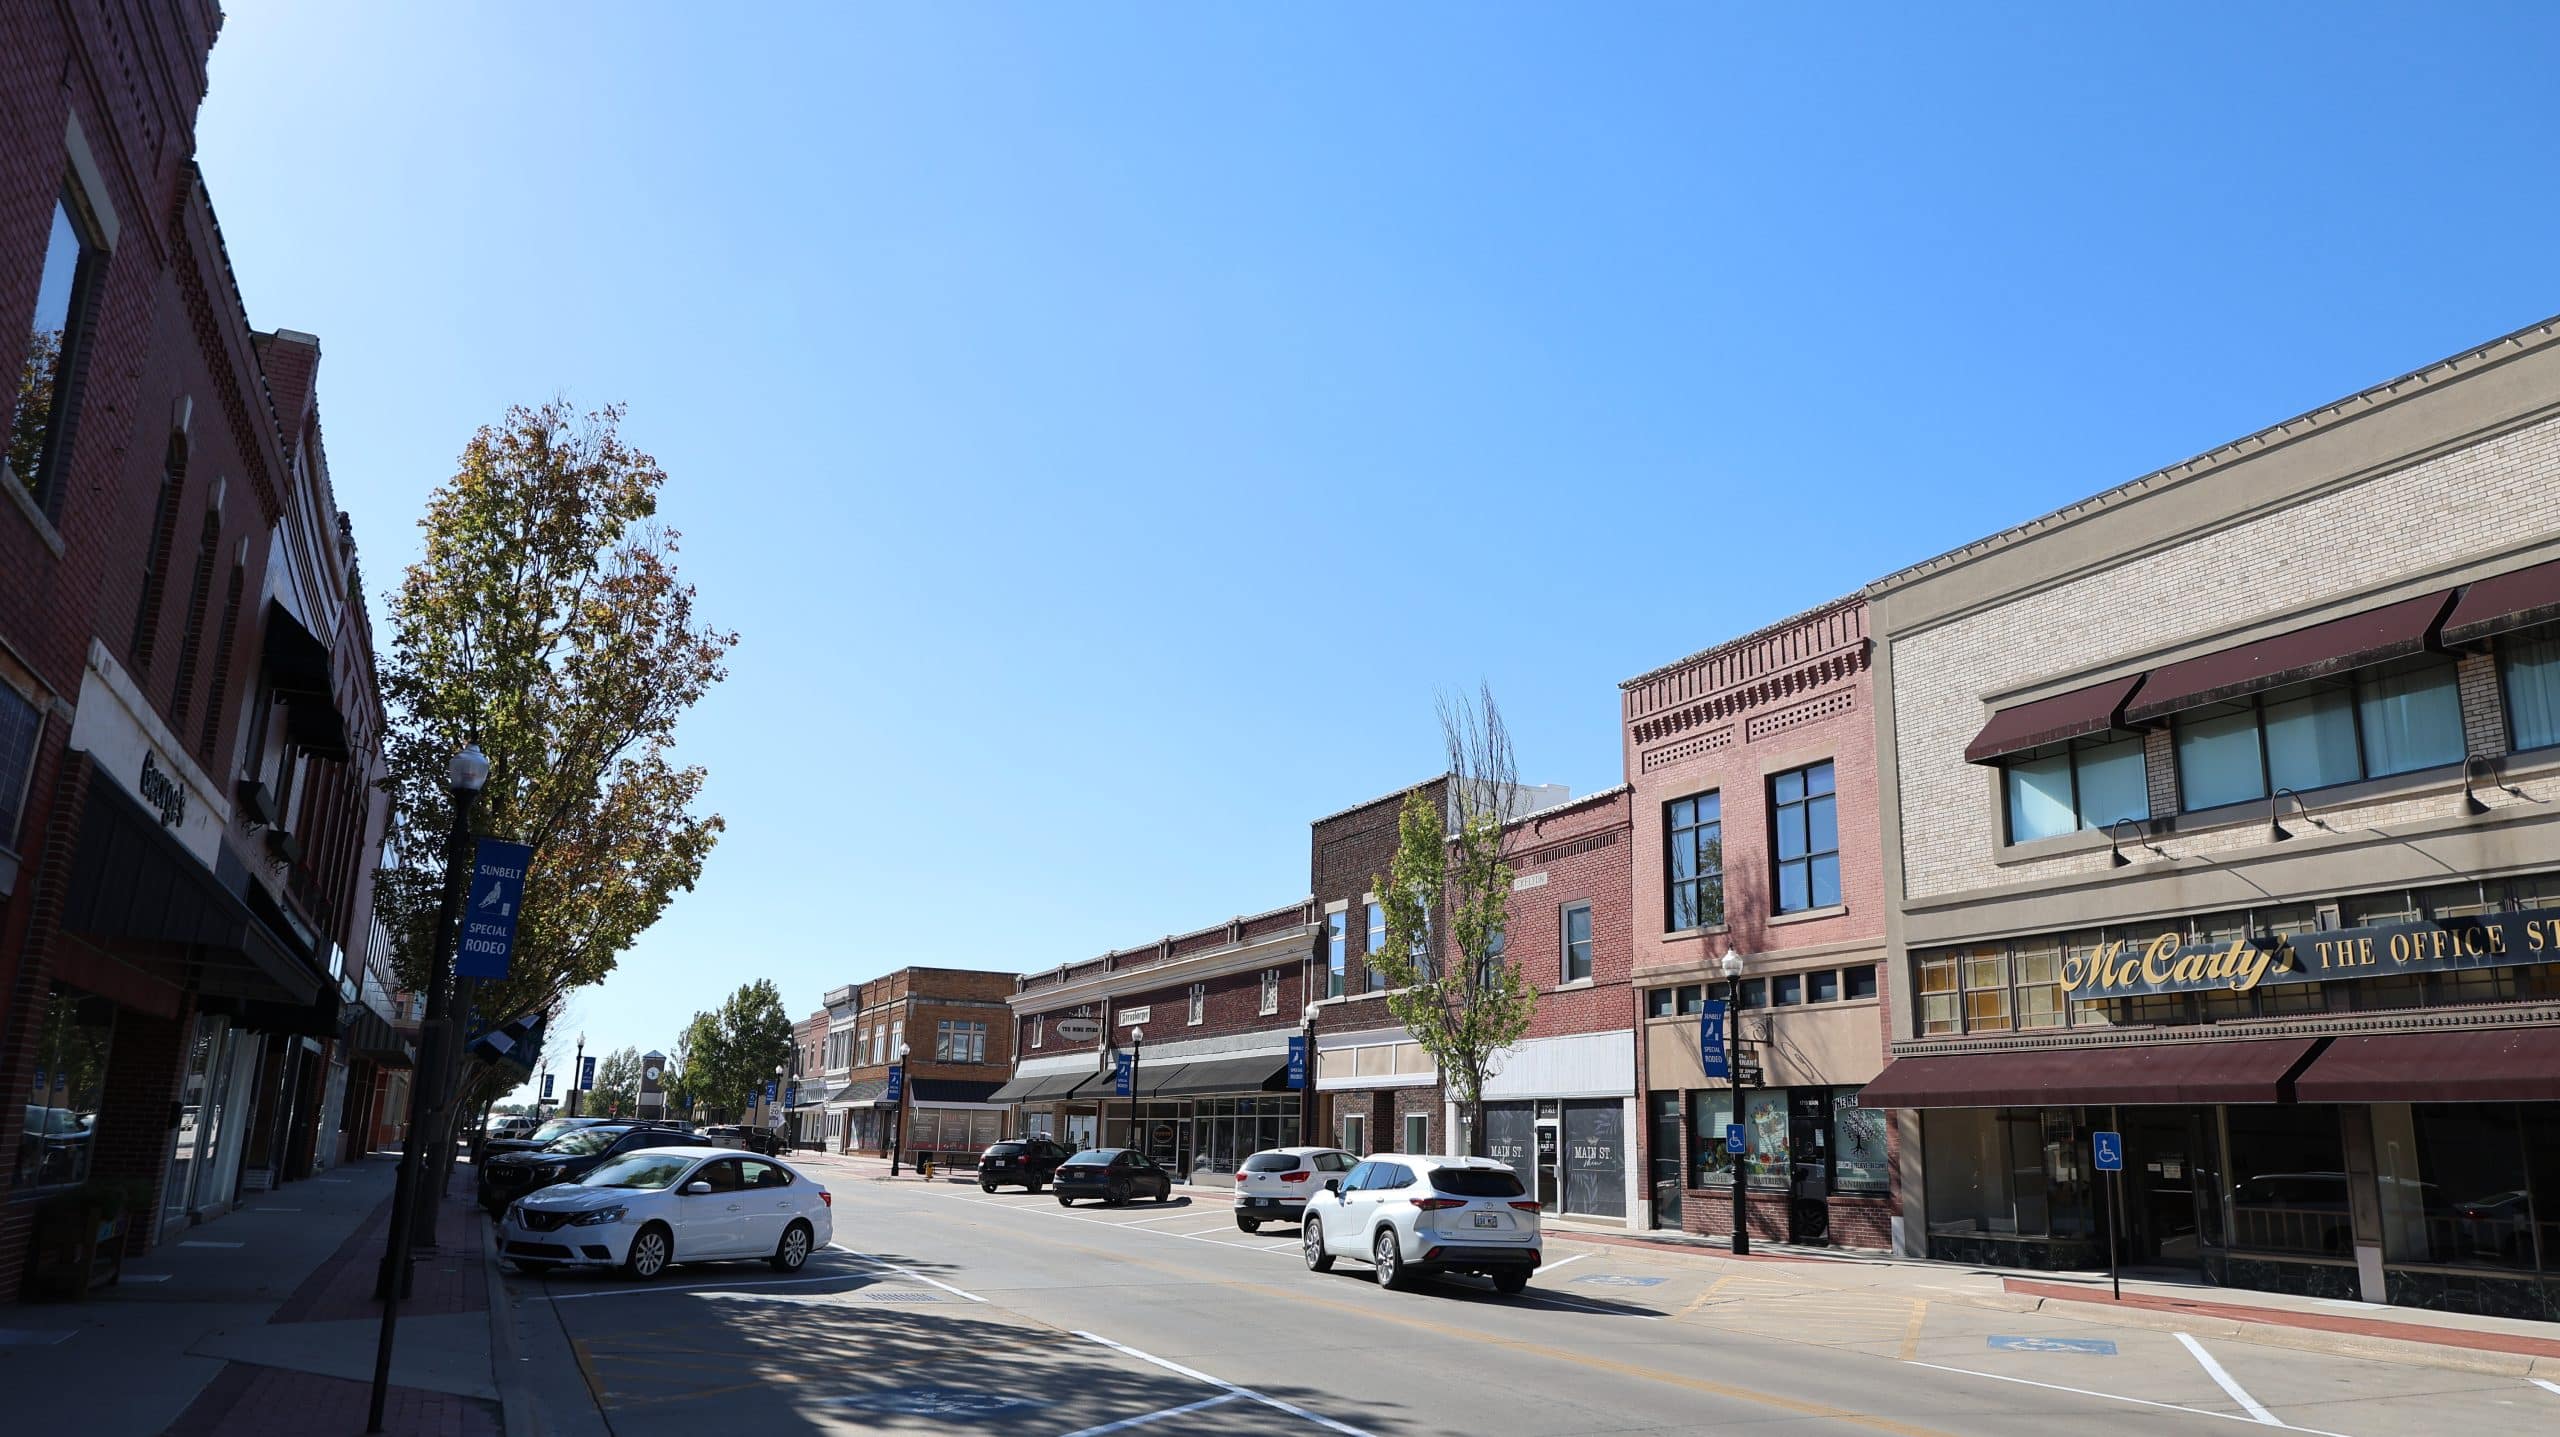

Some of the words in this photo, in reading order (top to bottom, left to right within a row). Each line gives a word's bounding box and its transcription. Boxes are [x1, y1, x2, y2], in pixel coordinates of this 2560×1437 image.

[480, 864, 522, 879] SUNBELT
[469, 922, 508, 937] SPECIAL
[465, 939, 506, 955] RODEO
[2060, 932, 2296, 991] McCarty's
[2316, 937, 2376, 969] THE
[2390, 924, 2506, 962] OFFICE
[1832, 1096, 1847, 1112] THE
[1491, 1145, 1510, 1158] MAIN
[1512, 1146, 1524, 1158] ST.
[1574, 1146, 1594, 1159] MAIN
[1599, 1147, 1613, 1159] ST.
